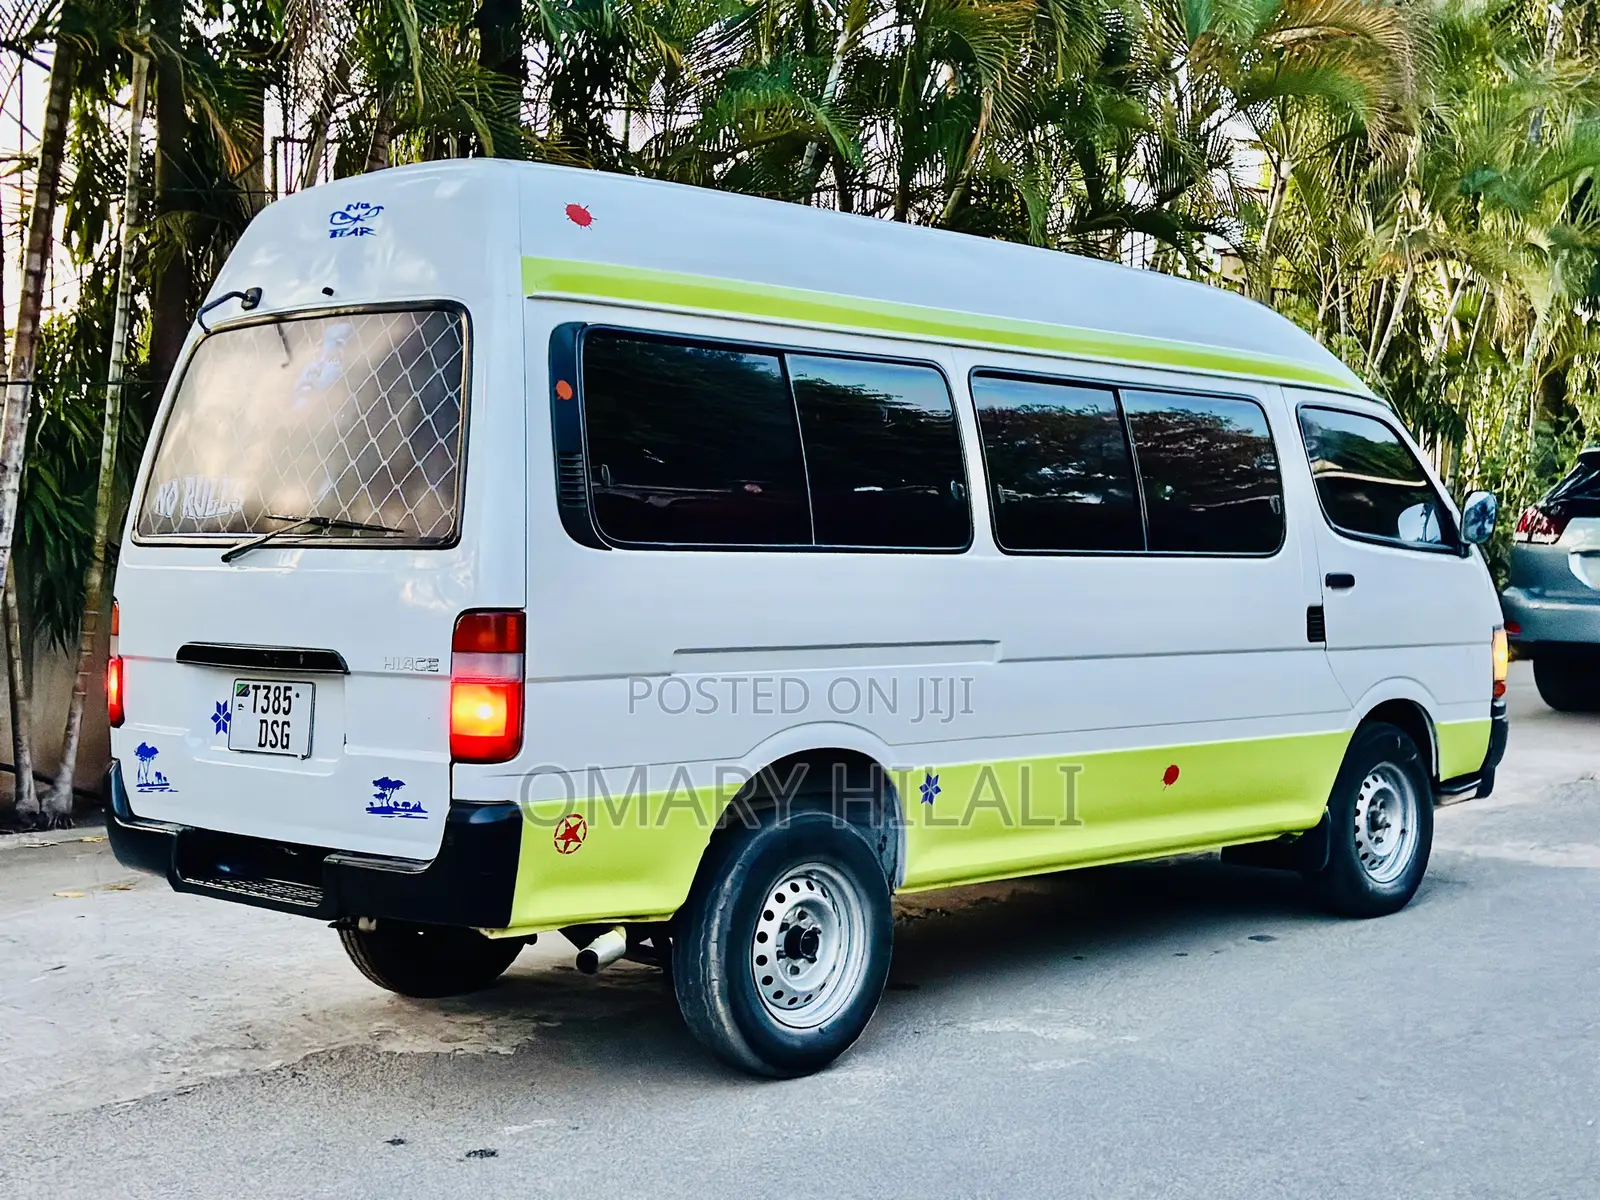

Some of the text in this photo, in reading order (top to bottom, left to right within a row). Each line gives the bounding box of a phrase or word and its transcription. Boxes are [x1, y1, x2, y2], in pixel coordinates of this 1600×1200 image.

[345, 202, 371, 211] NO
[154, 479, 178, 518] NO
[384, 656, 439, 672] HIACE
[252, 685, 292, 715] T385
[258, 719, 291, 749] DSG
